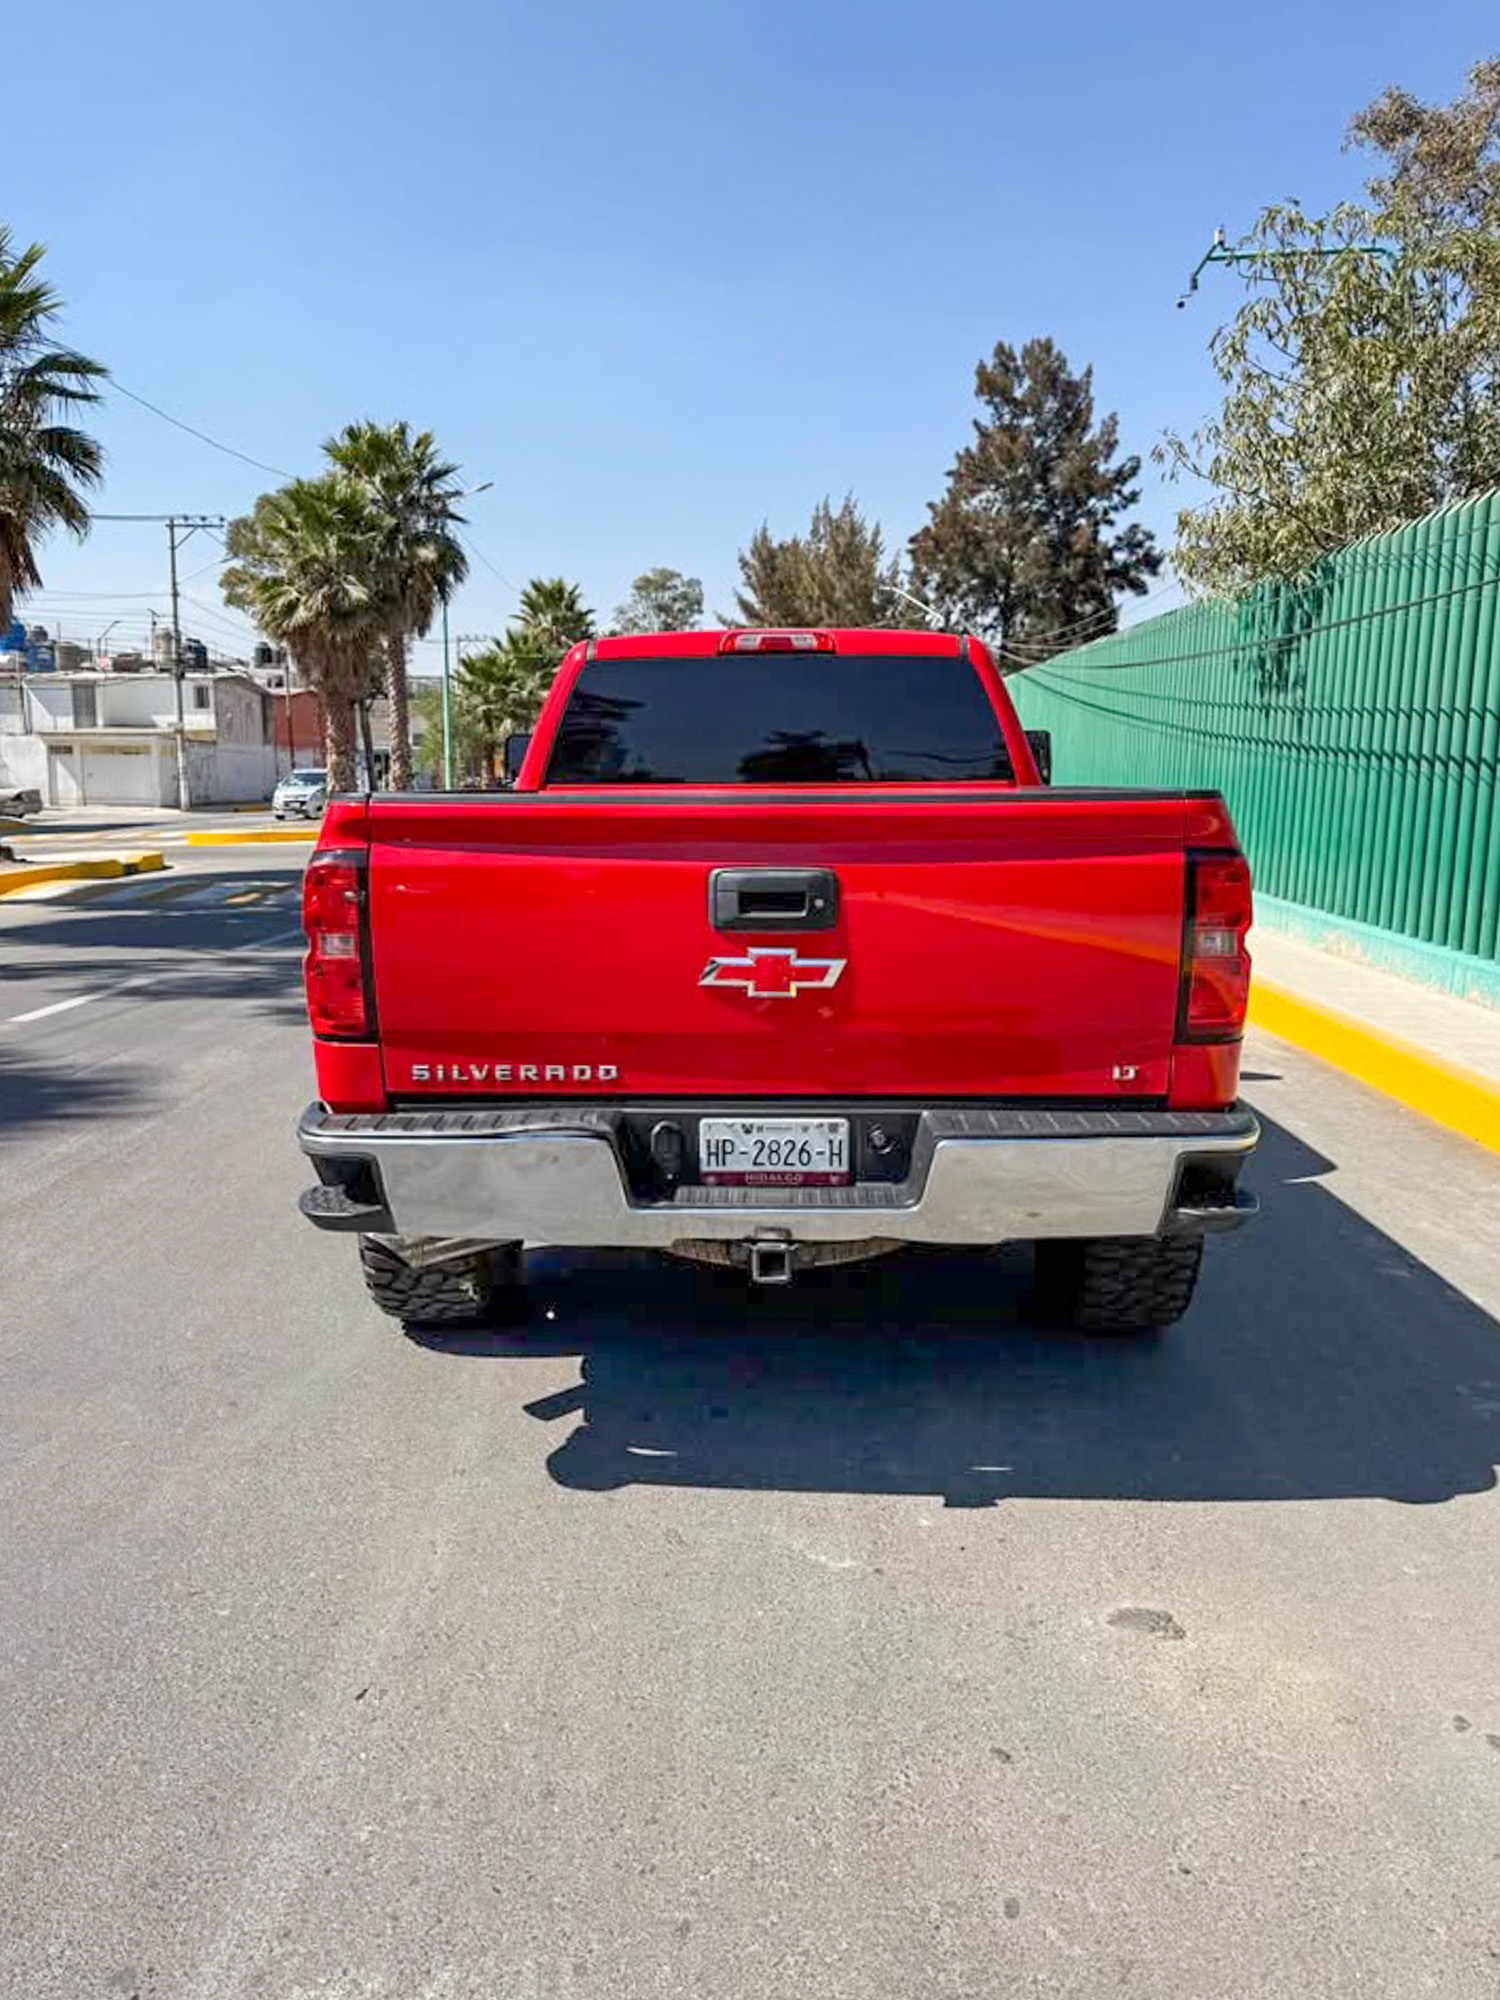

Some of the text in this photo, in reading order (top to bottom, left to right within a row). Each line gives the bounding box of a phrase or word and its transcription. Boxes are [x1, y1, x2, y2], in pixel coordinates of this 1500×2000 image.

[412, 1064, 618, 1081] SILVERADO
[705, 1138, 843, 1168] HP-2826-H
[745, 1173, 802, 1184] HIDALGO
